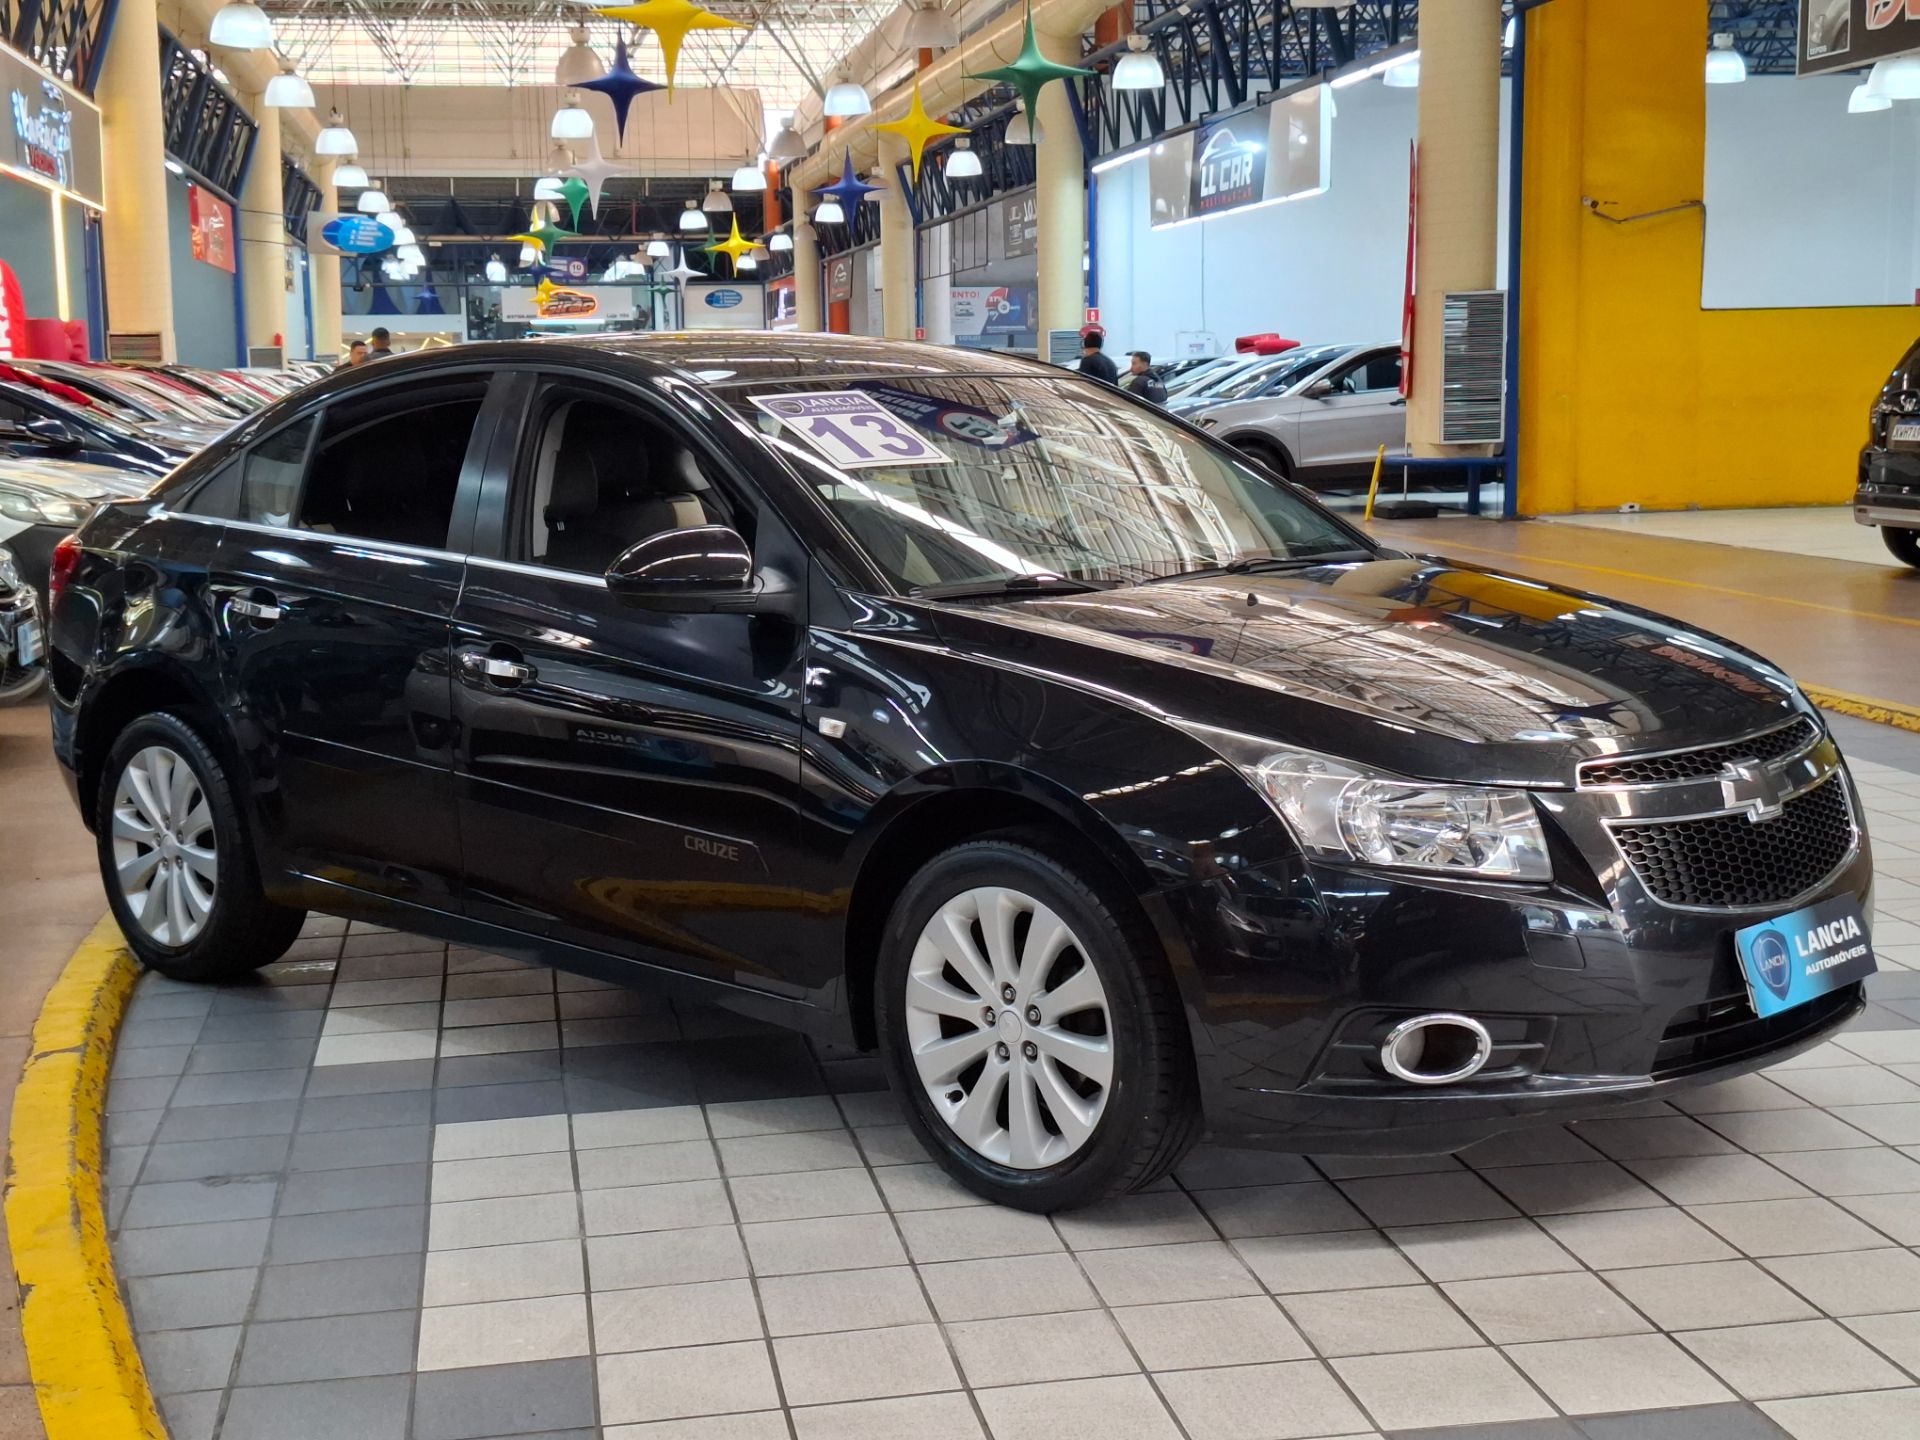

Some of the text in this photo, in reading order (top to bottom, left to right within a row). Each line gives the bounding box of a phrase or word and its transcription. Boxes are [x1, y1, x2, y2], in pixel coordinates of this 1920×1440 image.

[1220, 152, 1253, 192] CAR
[951, 290, 980, 299] ENTO!
[798, 397, 869, 407] LANCIA
[808, 415, 925, 458] 13
[684, 836, 739, 861] CRUZE
[1795, 915, 1861, 957] LANCIA
[1760, 954, 1787, 972] LANCIA
[1805, 944, 1868, 976] AUTOMÓVEIS
